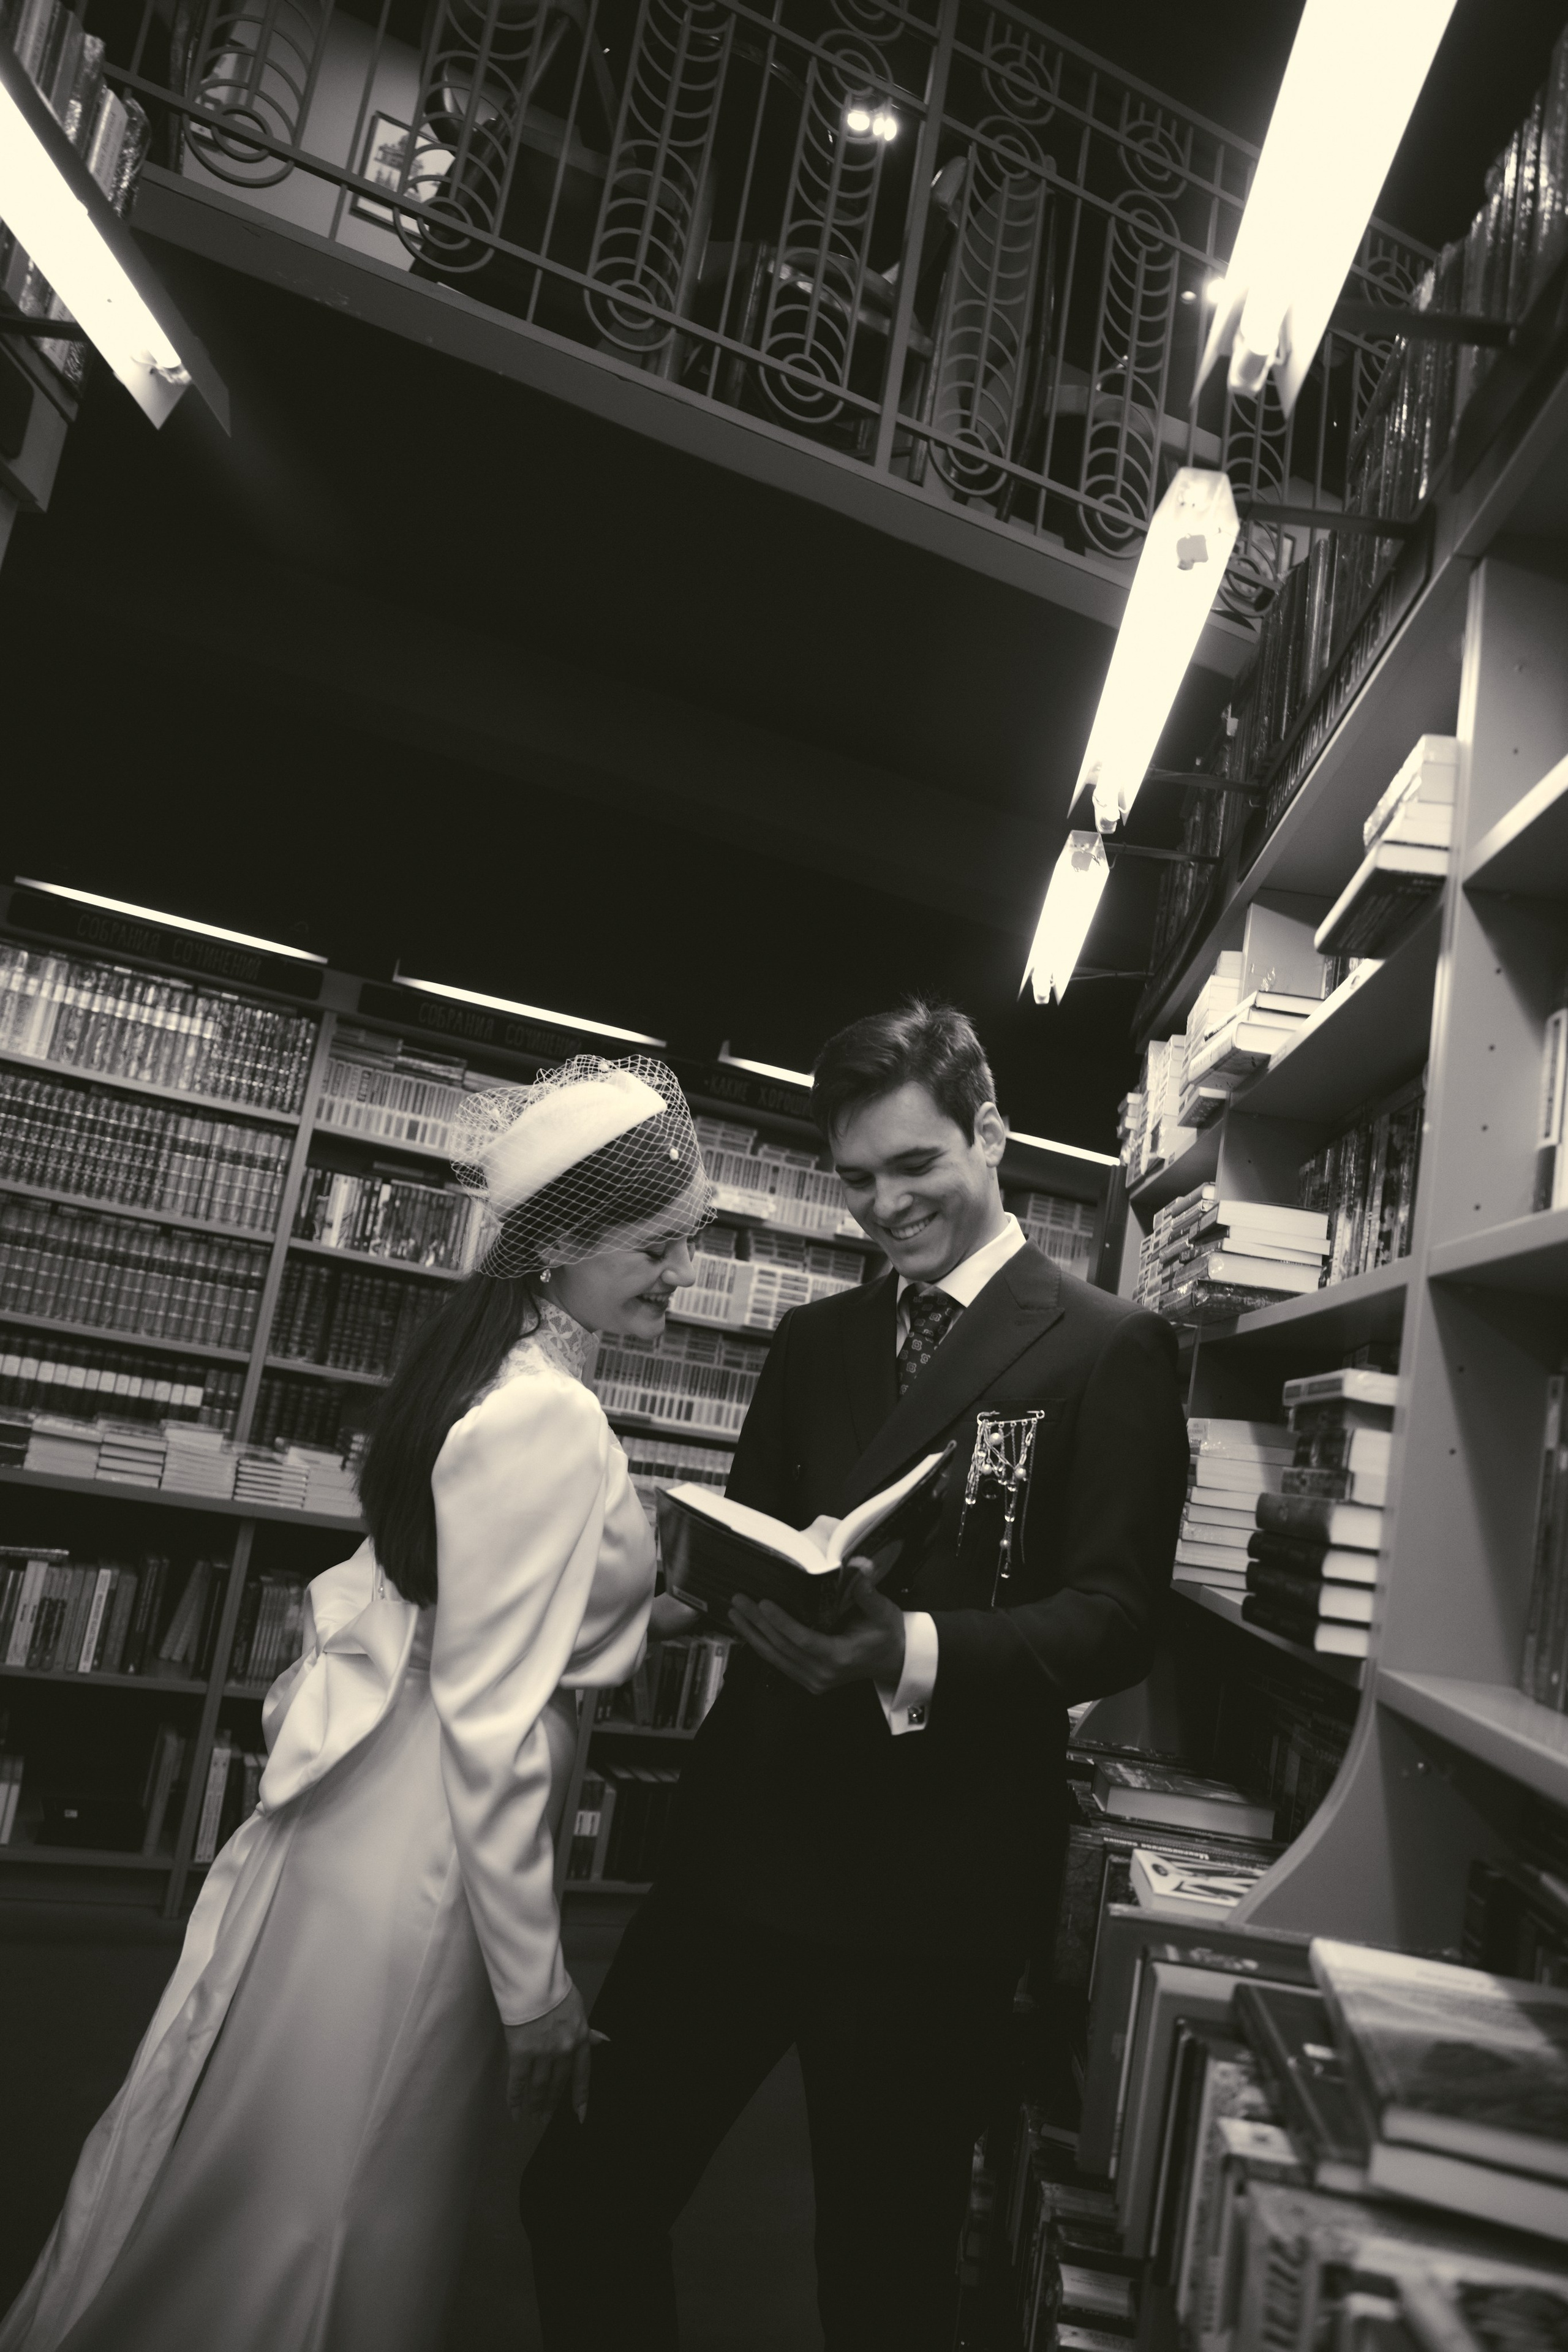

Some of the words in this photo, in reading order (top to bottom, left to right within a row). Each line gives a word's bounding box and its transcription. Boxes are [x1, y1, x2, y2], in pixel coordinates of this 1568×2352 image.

[77, 913, 161, 956] СОБРАНИЯ
[171, 938, 262, 981] СОЧИНЕНИЙ
[418, 1001, 495, 1041] СОБРАНИЯ
